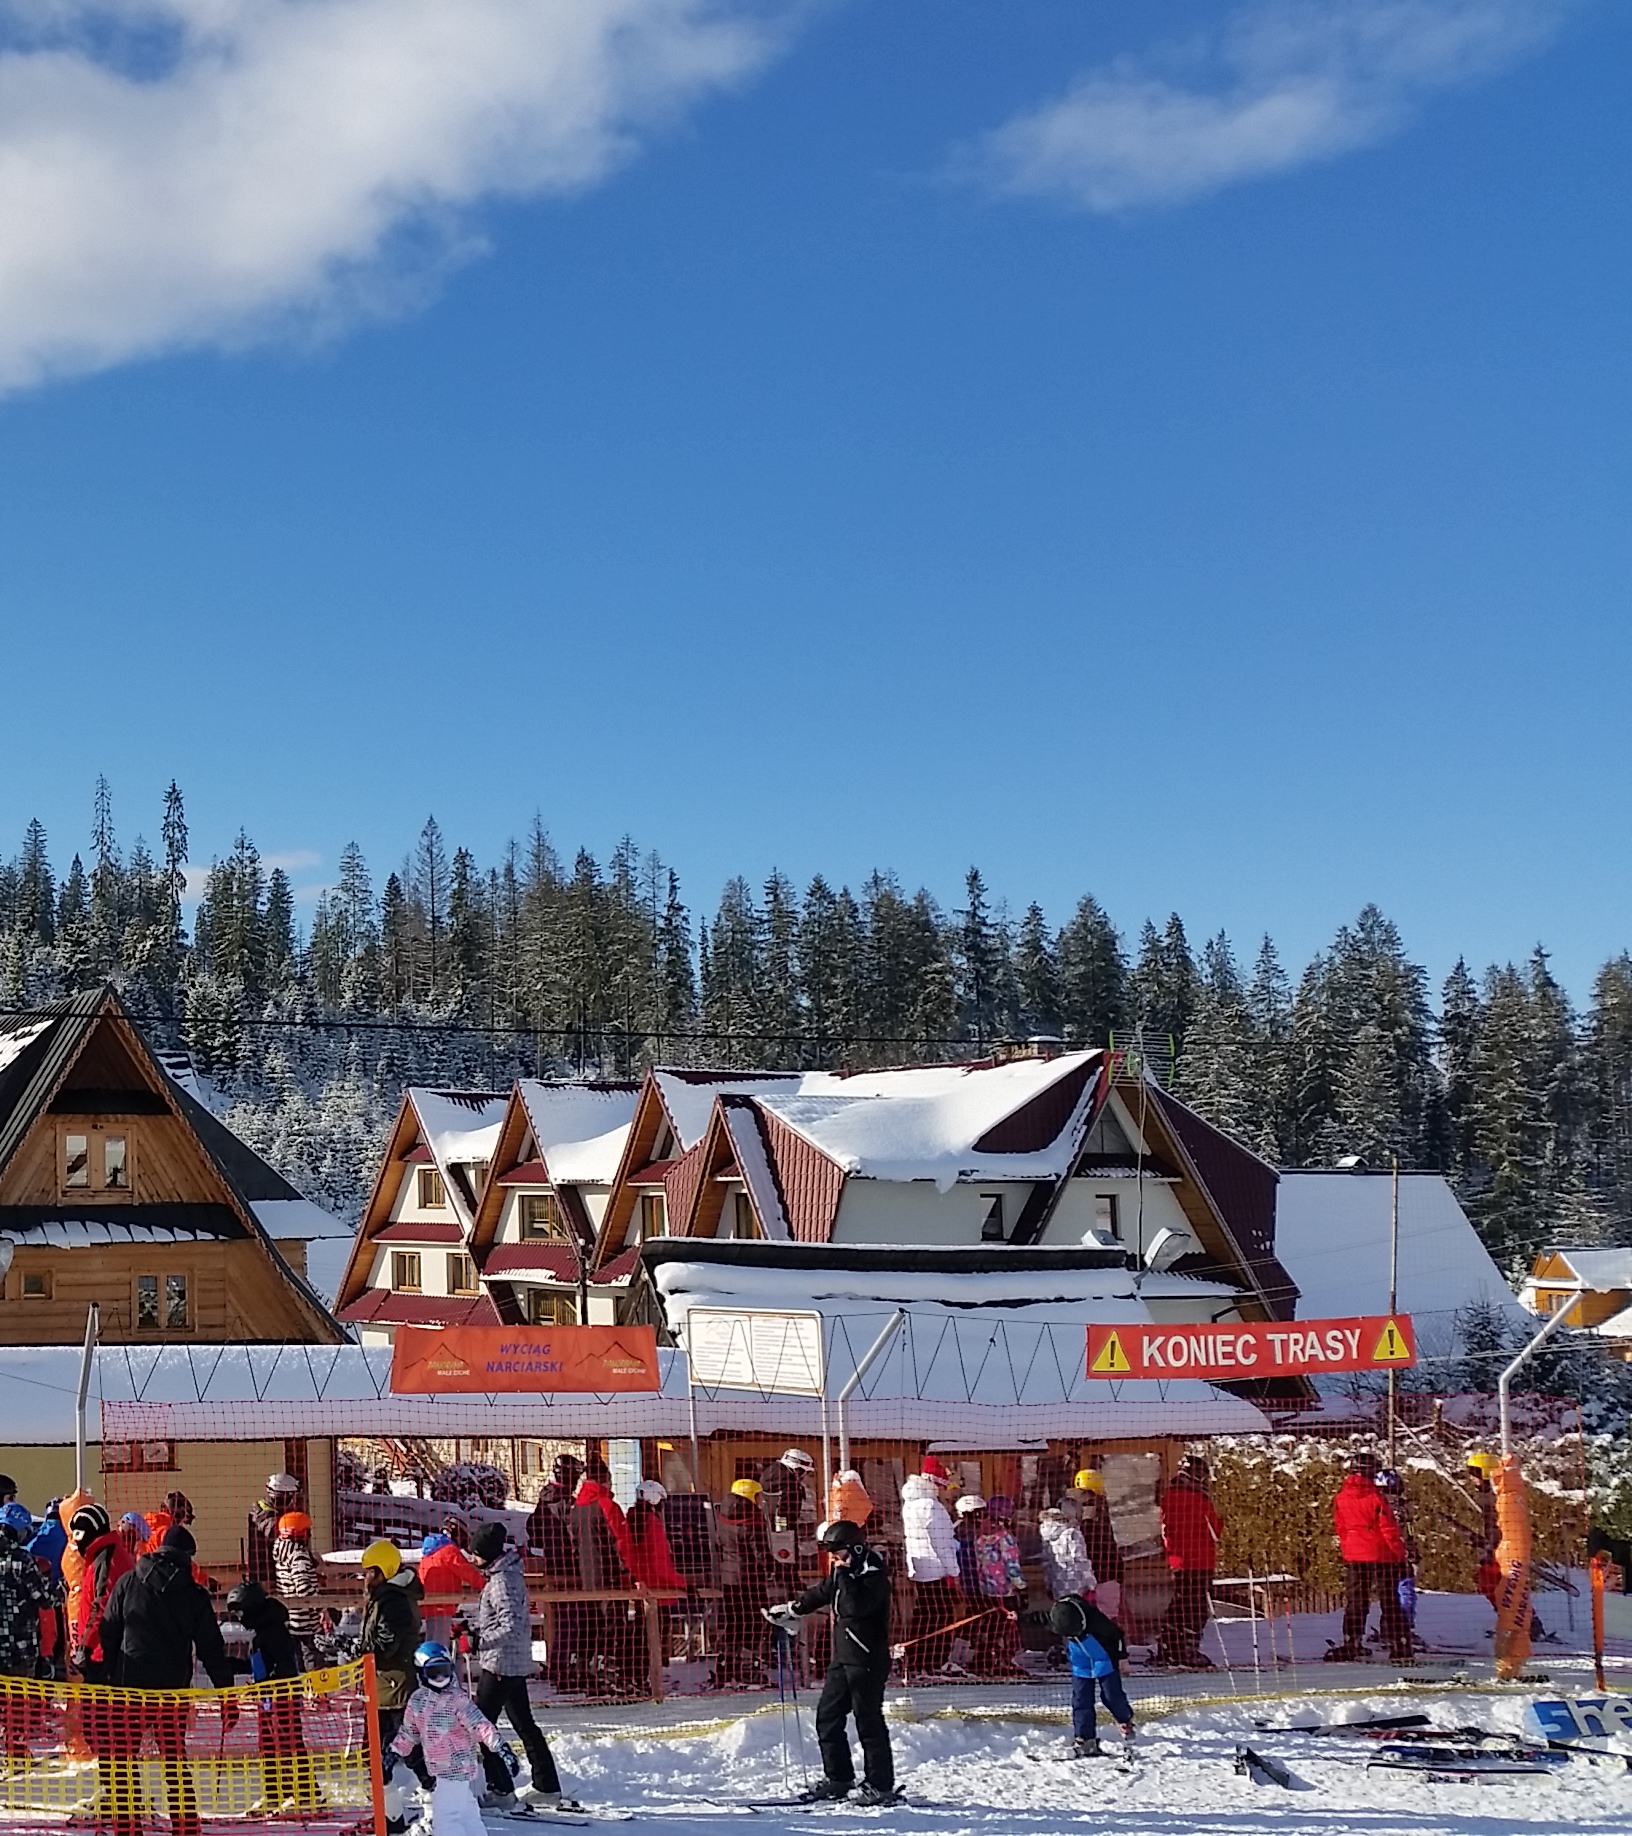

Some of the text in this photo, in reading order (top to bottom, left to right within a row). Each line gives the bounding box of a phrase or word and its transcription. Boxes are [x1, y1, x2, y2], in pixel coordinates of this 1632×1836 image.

[499, 1344, 551, 1357] WYCIĄG
[1142, 1328, 1361, 1368] KONIEC TRASY
[485, 1361, 563, 1373] NARCIARSKI
